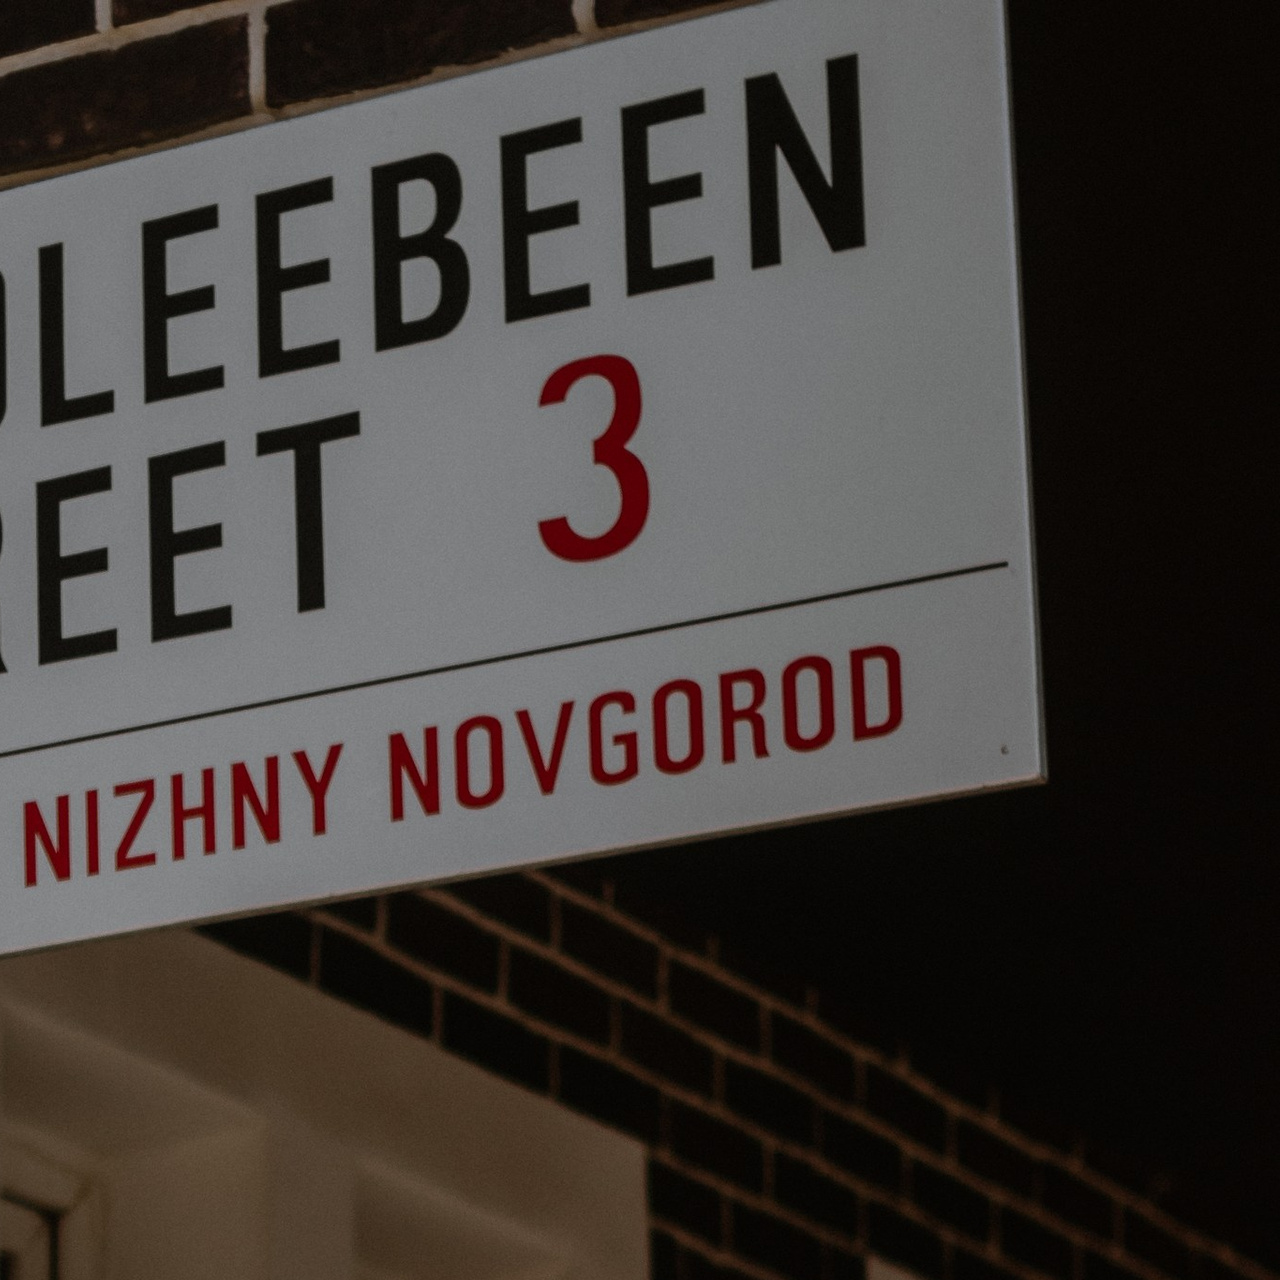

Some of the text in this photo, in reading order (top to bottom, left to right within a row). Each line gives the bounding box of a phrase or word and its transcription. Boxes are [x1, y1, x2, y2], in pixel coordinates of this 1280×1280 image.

[537, 353, 651, 564] 3
[22, 742, 344, 888] NIZHNY
[387, 643, 905, 823] NOVGOROD
